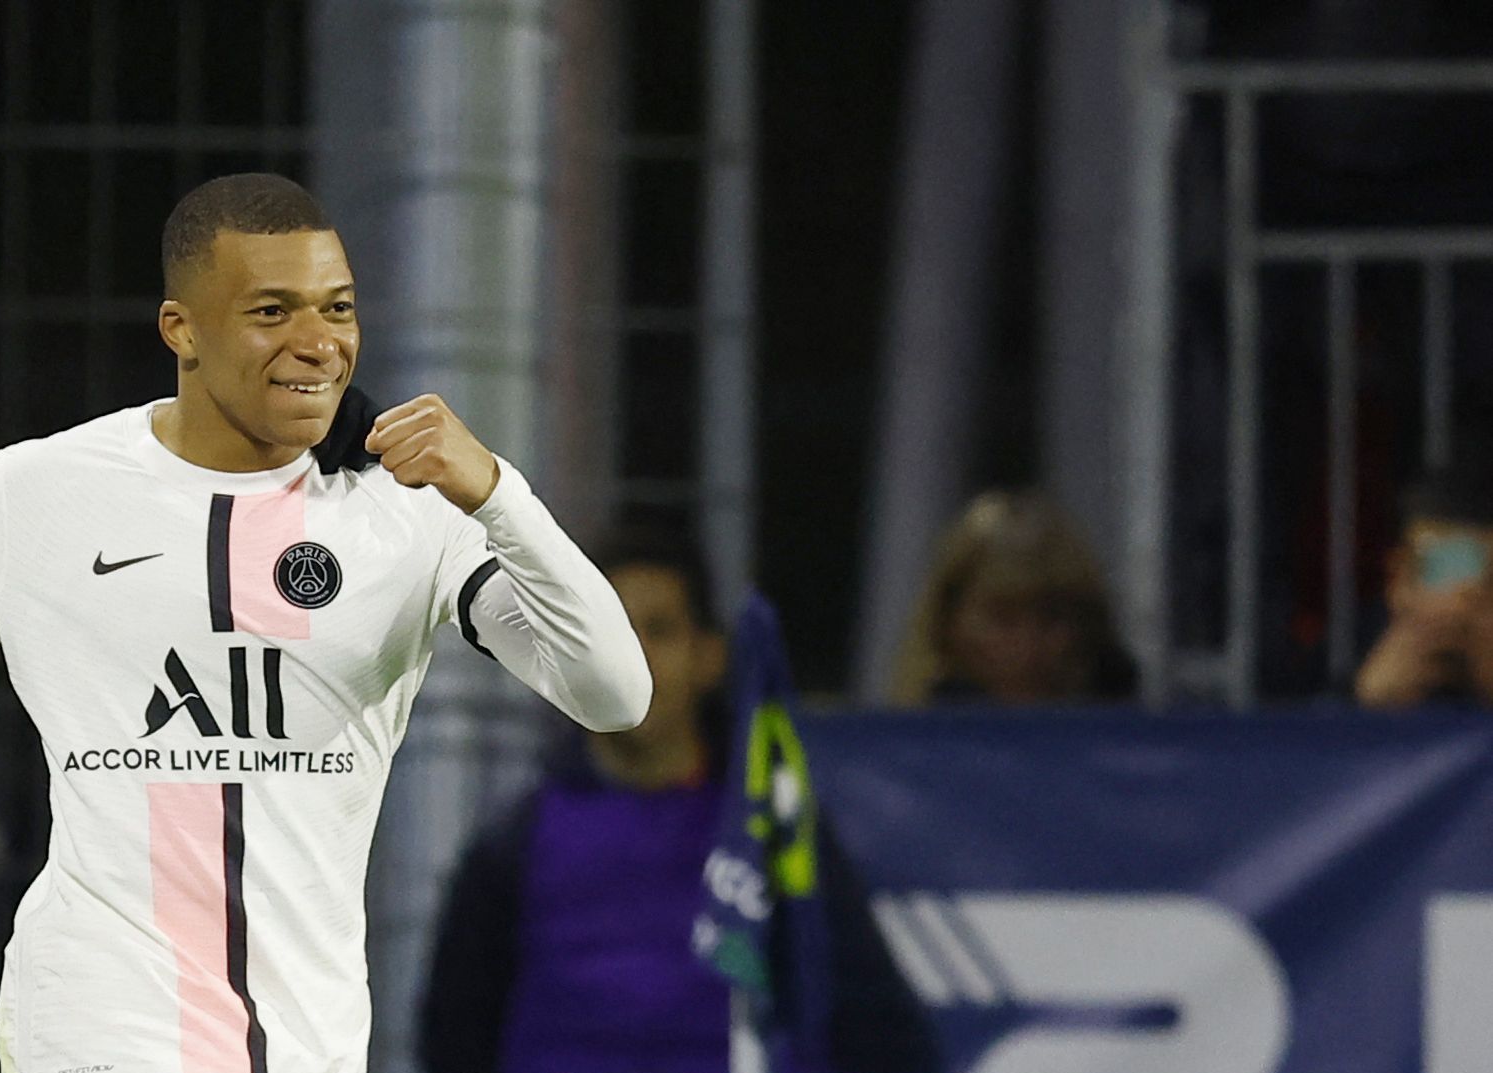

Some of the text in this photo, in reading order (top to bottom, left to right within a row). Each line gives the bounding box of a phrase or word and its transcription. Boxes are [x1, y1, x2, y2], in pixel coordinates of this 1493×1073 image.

[286, 547, 327, 563] PARIS
[63, 749, 355, 773] ACCOR LIVE LIMITLESS
